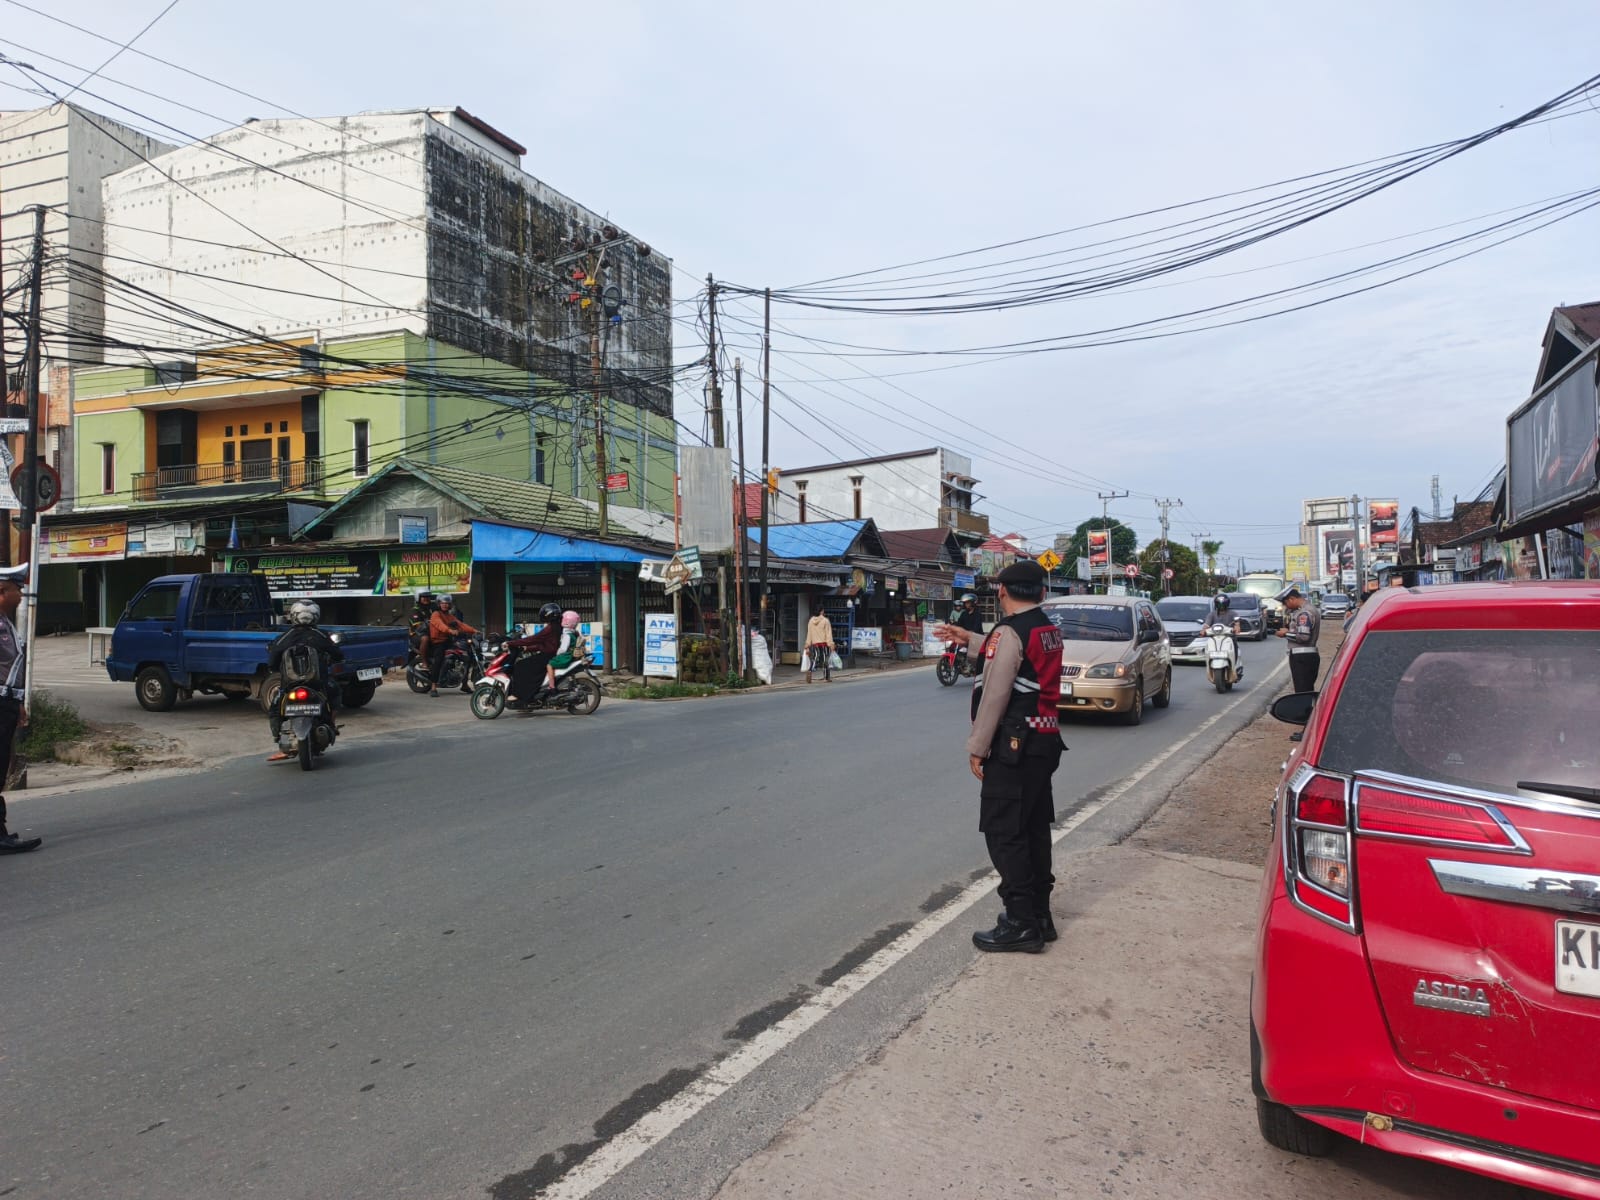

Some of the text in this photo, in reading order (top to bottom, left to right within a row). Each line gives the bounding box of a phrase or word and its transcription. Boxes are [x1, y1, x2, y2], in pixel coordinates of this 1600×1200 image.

[433, 562, 467, 577] BANJAR
[650, 620, 674, 629] ATM
[1041, 630, 1063, 651] POLIS
[1415, 979, 1488, 1003] ASTRA
[1416, 995, 1488, 1016] TOYOTA
